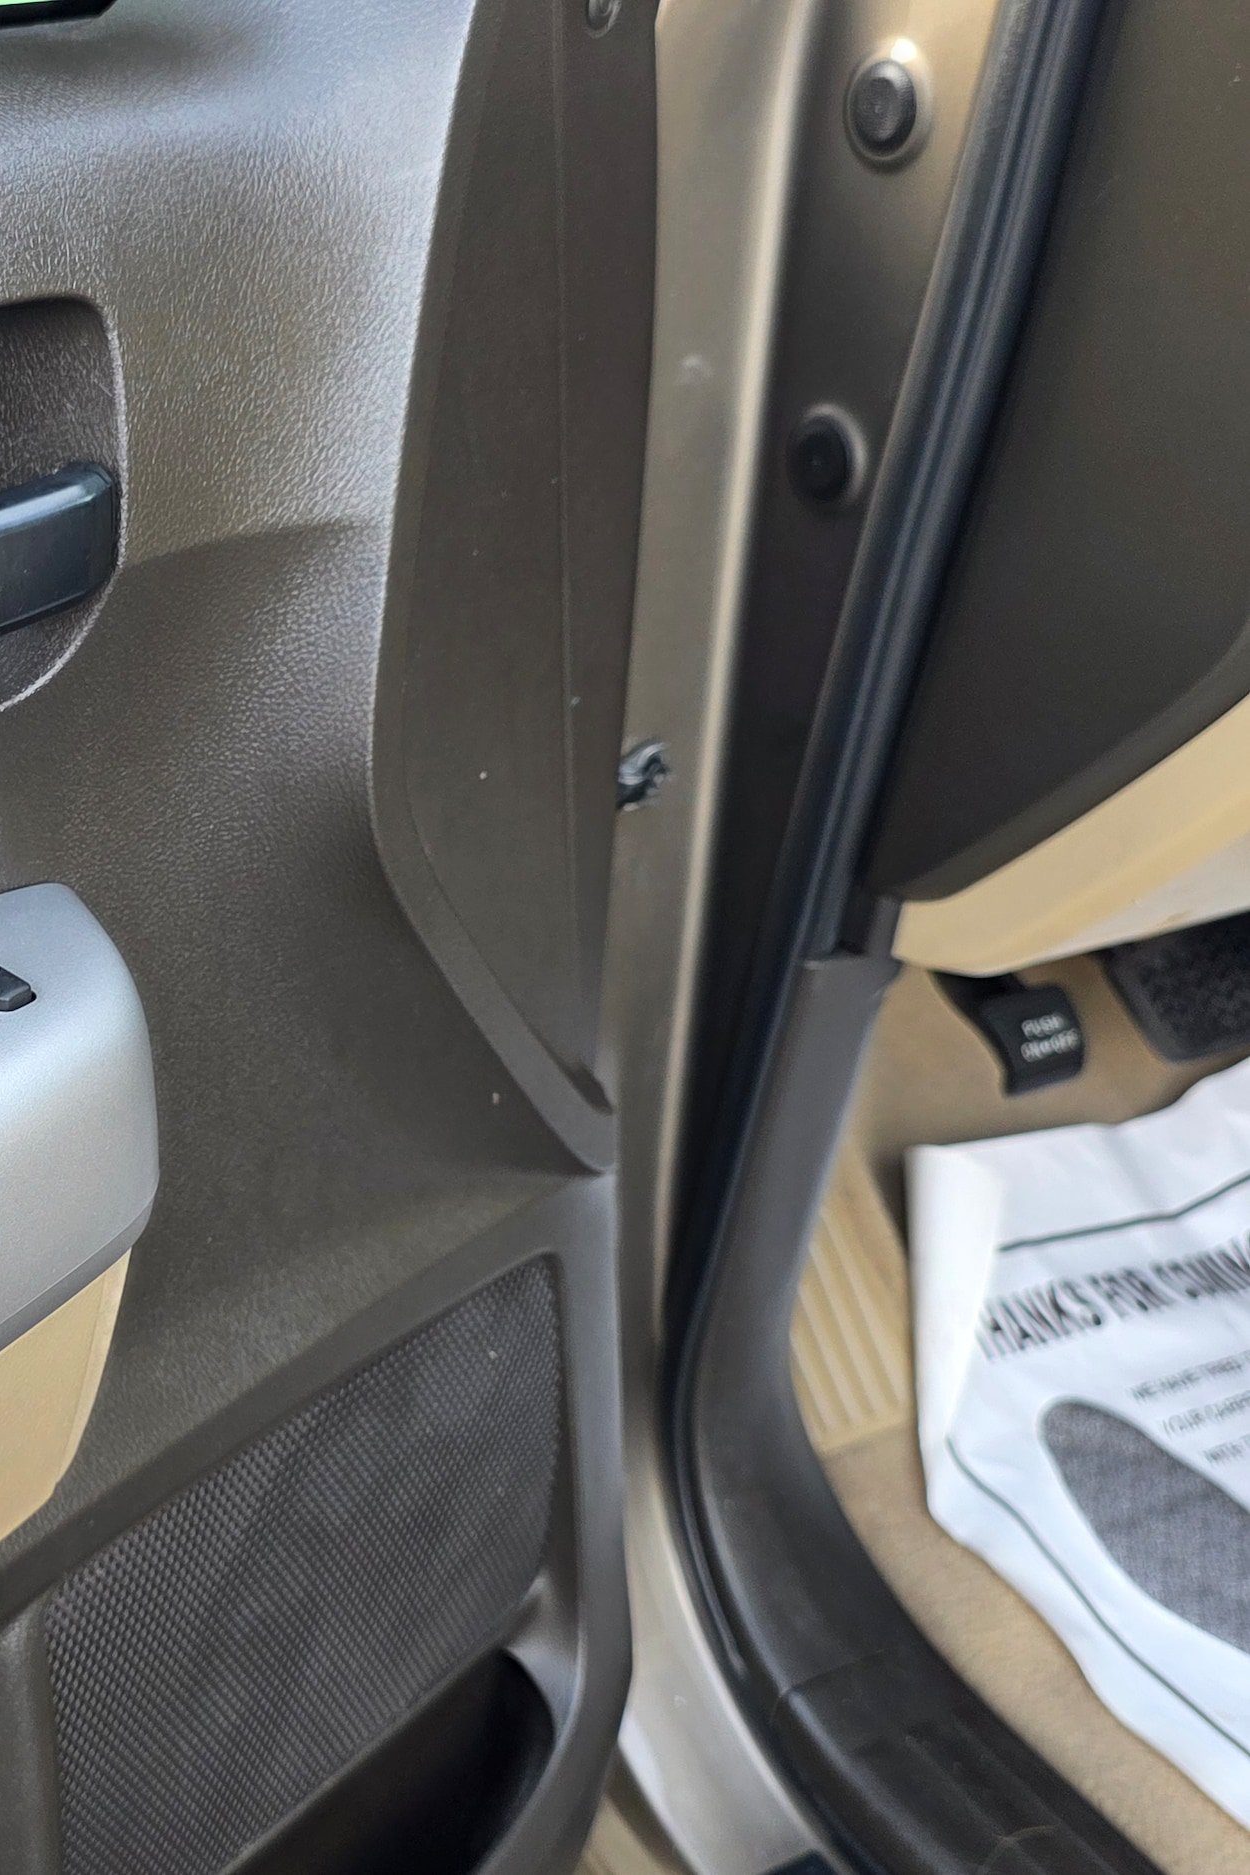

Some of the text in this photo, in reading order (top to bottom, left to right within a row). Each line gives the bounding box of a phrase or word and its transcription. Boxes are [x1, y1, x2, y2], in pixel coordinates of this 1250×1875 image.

[1022, 1014, 1064, 1040] PUSH
[1088, 1269, 1168, 1317] FOR
[1152, 1229, 1250, 1299] COMIN
